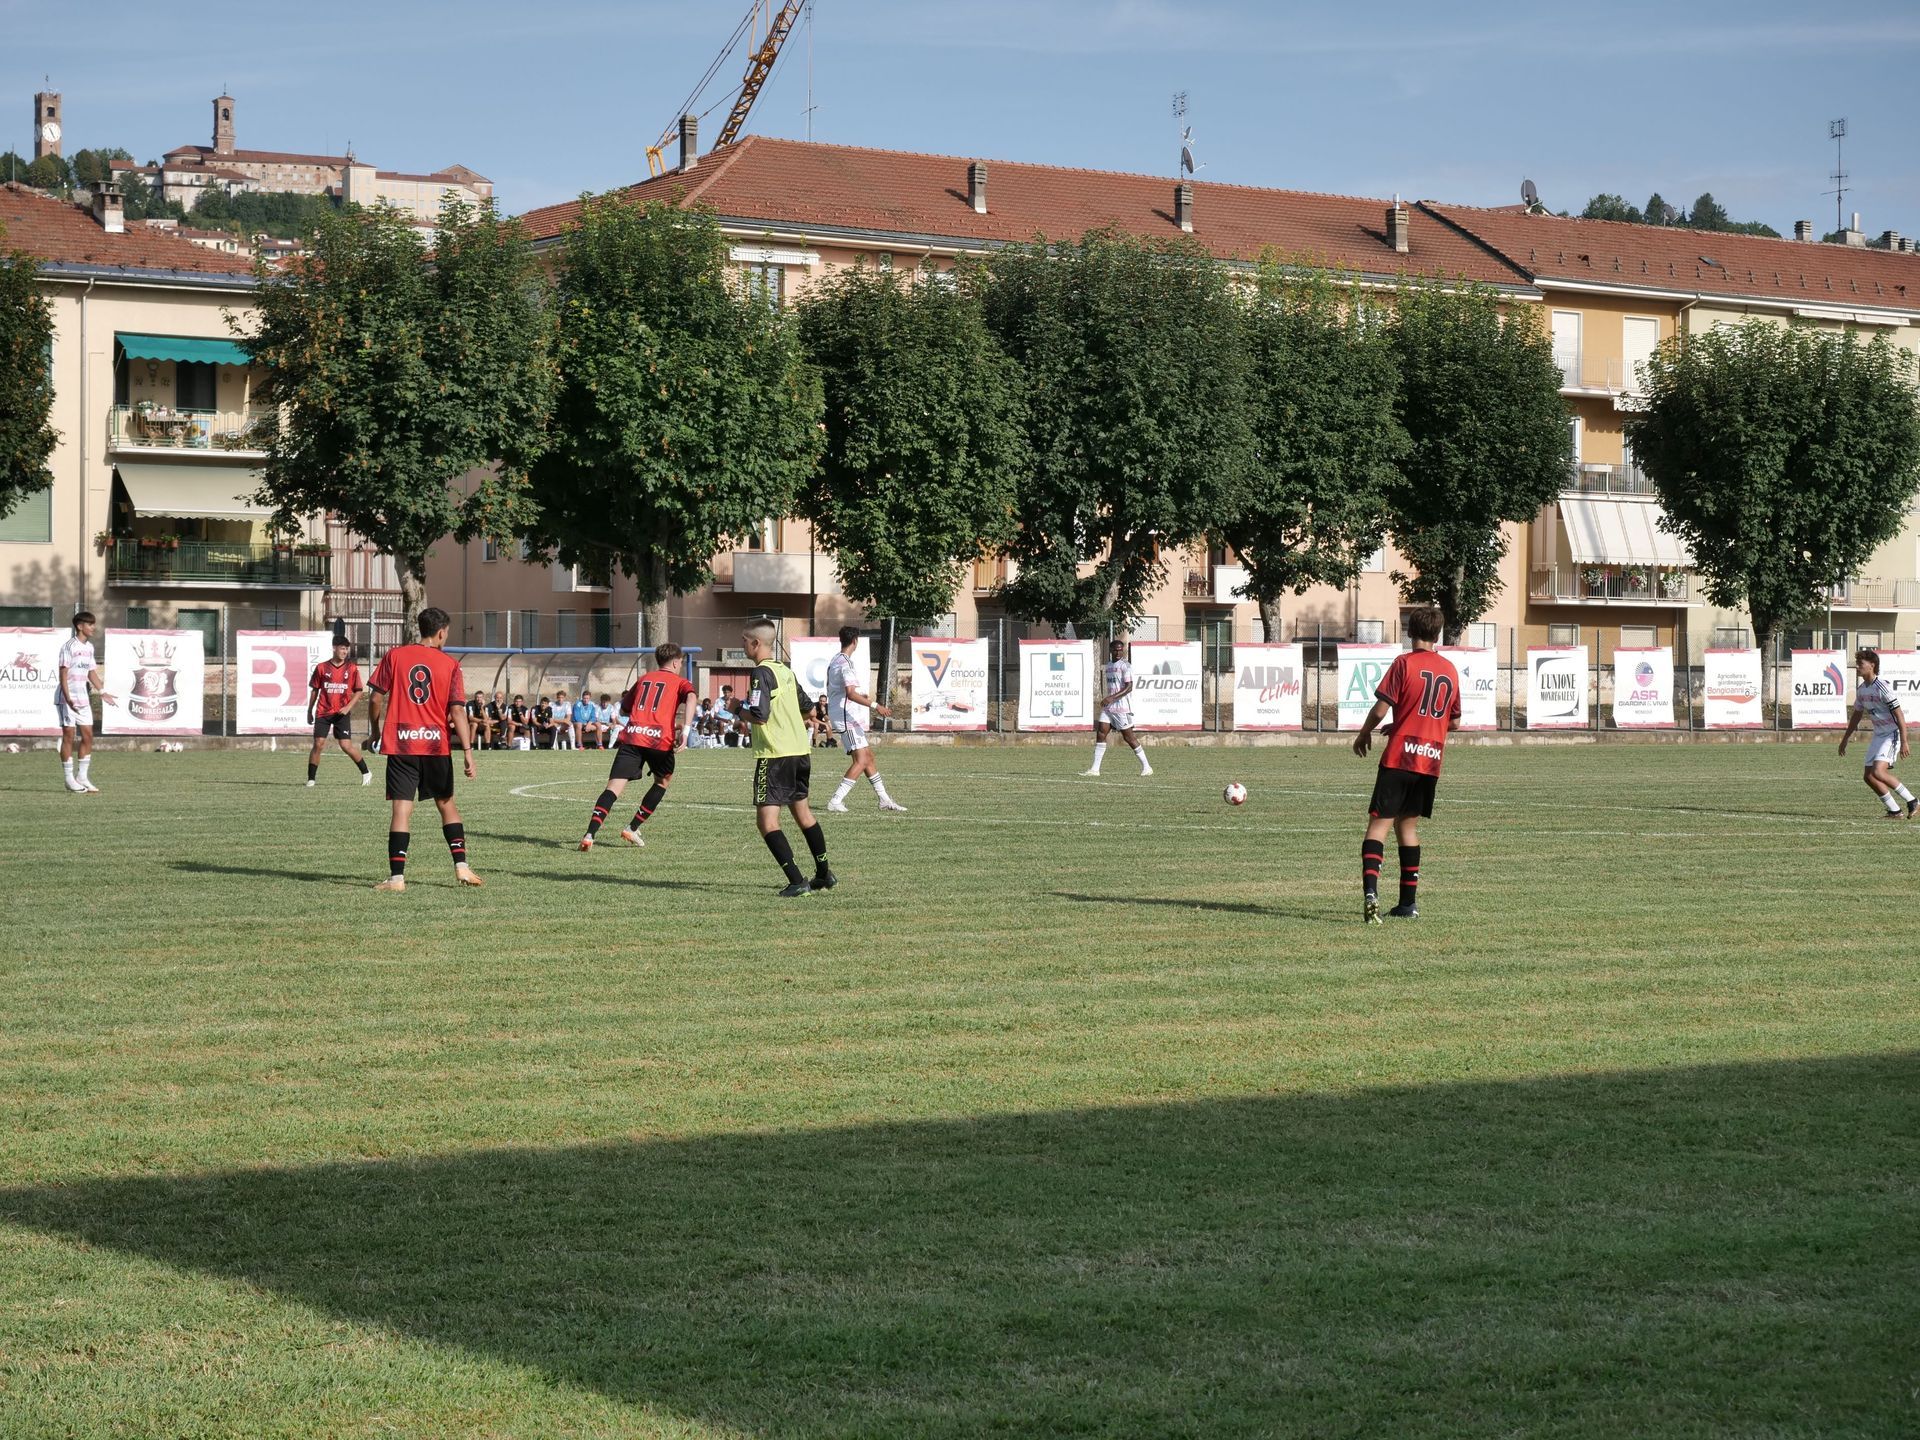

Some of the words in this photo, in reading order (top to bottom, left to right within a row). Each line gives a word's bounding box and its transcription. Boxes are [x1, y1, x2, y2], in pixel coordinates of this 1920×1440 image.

[0, 668, 58, 682] ALLOLA
[408, 664, 432, 705] 8
[1135, 676, 1184, 690] bruno
[1794, 682, 1834, 696] SA.BEL
[637, 681, 666, 711] 11
[1259, 680, 1300, 703] CLIMA
[1418, 670, 1453, 719] 10
[1630, 690, 1658, 700] ASR
[398, 726, 441, 741] wefox
[627, 725, 661, 738] wefox
[1404, 741, 1441, 760] wefox
